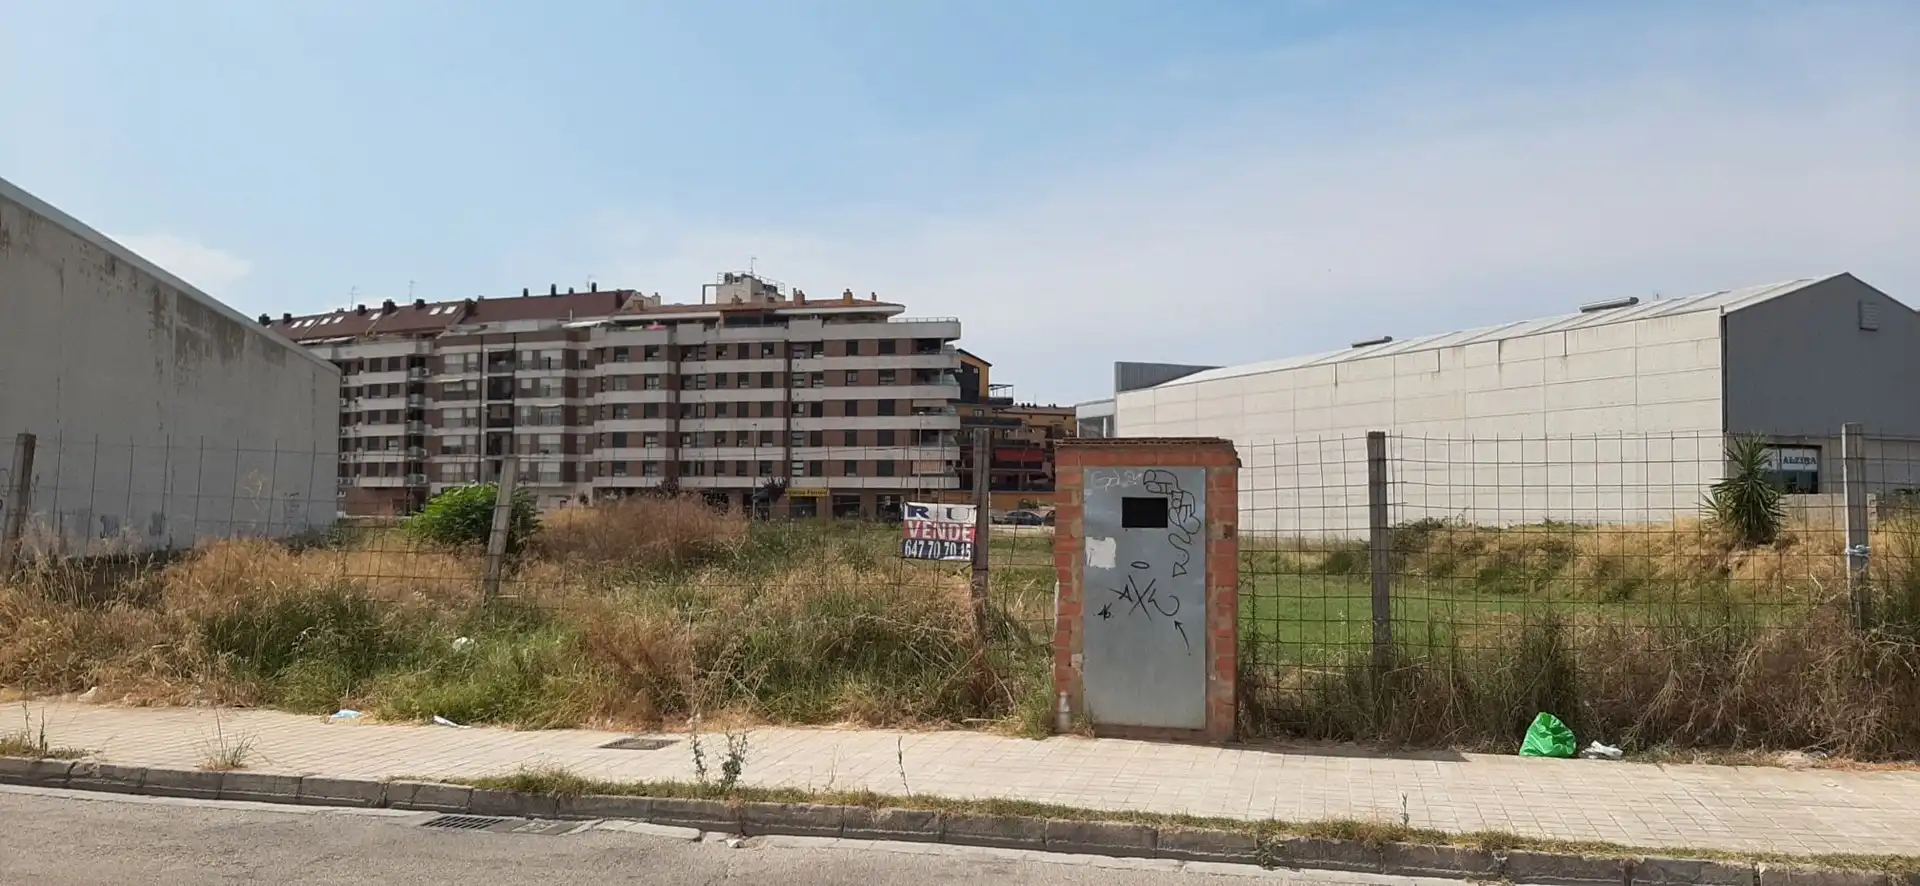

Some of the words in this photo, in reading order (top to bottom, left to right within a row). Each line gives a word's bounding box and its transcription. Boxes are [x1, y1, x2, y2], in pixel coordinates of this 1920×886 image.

[908, 520, 972, 541] VENDE
[904, 539, 924, 558] 647
[928, 540, 941, 559] 70
[944, 541, 957, 557] 70
